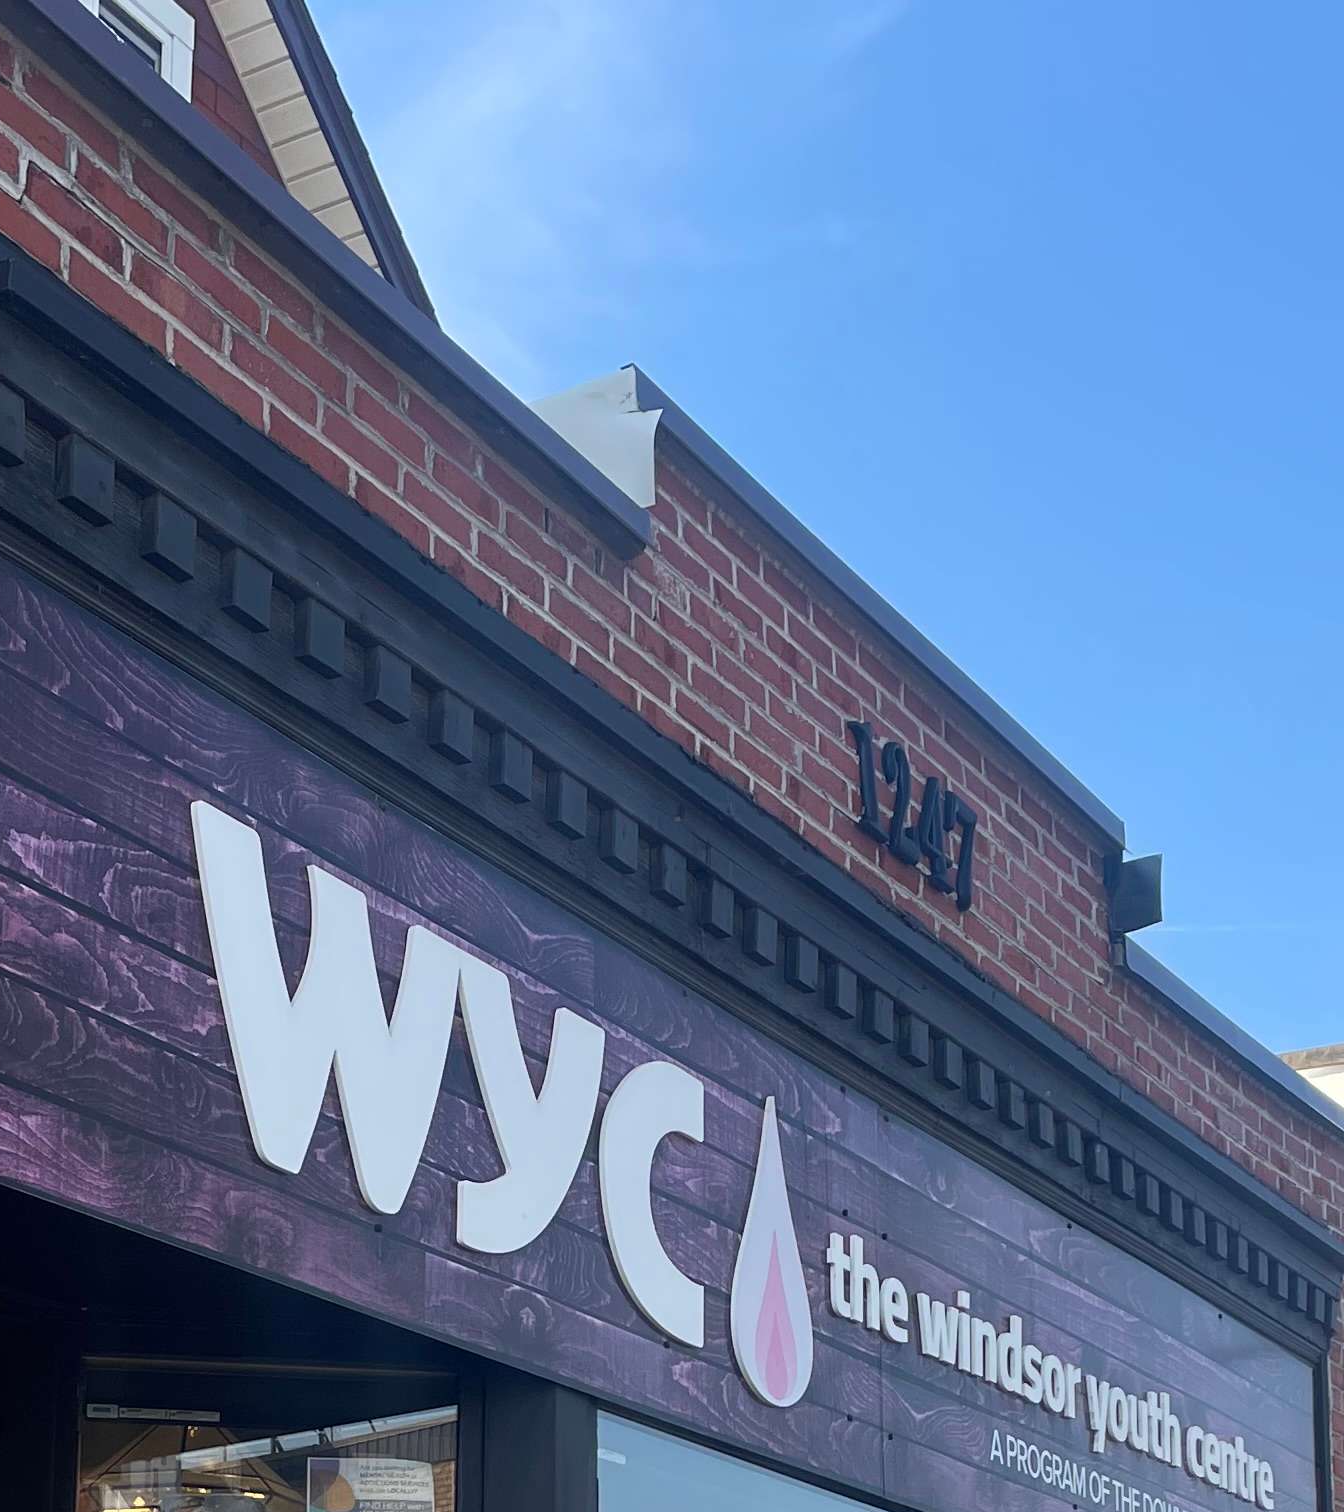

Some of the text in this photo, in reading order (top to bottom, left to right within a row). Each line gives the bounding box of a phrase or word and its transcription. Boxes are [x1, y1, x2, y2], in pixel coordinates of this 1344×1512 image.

[847, 721, 977, 912] 1247
[826, 1232, 1274, 1510] the windsor youth centre
[990, 1430, 1004, 1463] A
[1006, 1438, 1087, 1498] PROGRAM
[1089, 1471, 1111, 1507] OF
